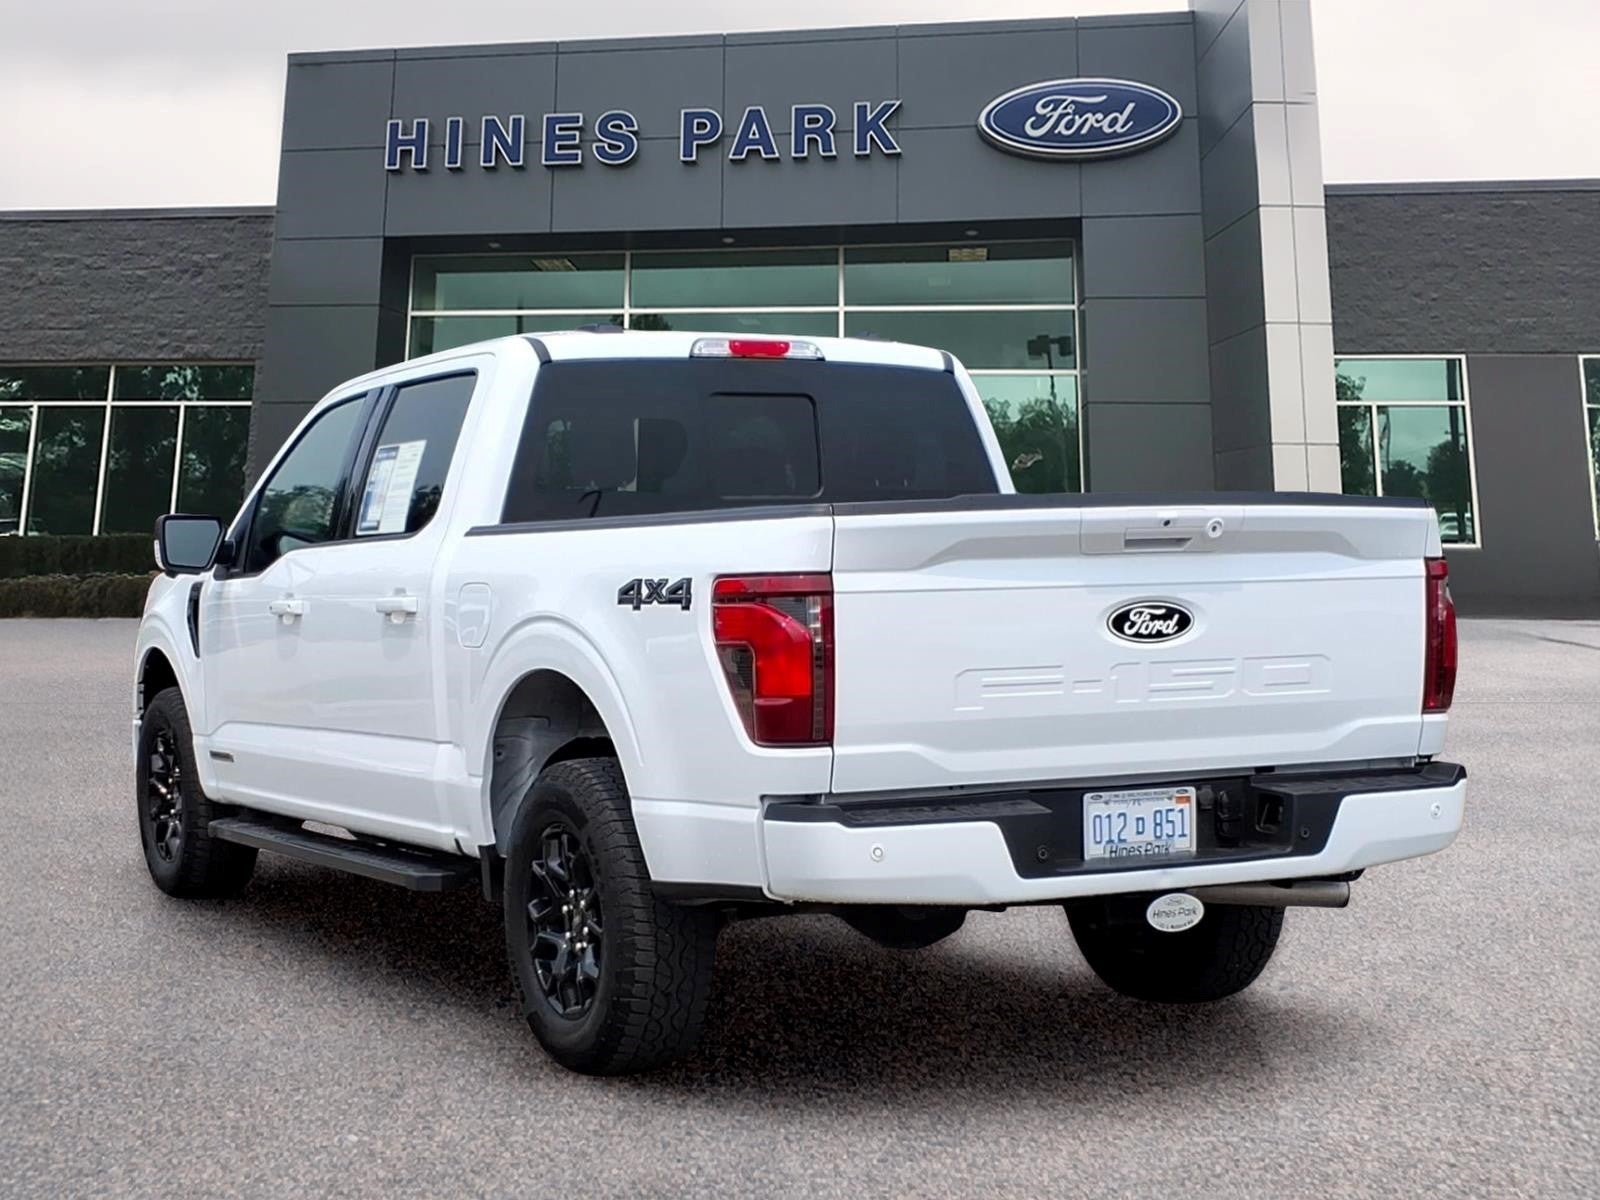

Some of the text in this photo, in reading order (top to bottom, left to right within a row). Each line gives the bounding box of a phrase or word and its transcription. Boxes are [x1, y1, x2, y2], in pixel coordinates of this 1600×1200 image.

[1024, 94, 1137, 137] Ford
[384, 99, 902, 171] HINES PARK
[1122, 606, 1180, 637] Ford
[953, 654, 1332, 711] F-150
[1092, 811, 1128, 845] 012
[1153, 808, 1188, 840] 851
[1109, 841, 1172, 858] Hines Park
[1153, 905, 1198, 919] Hines Park
